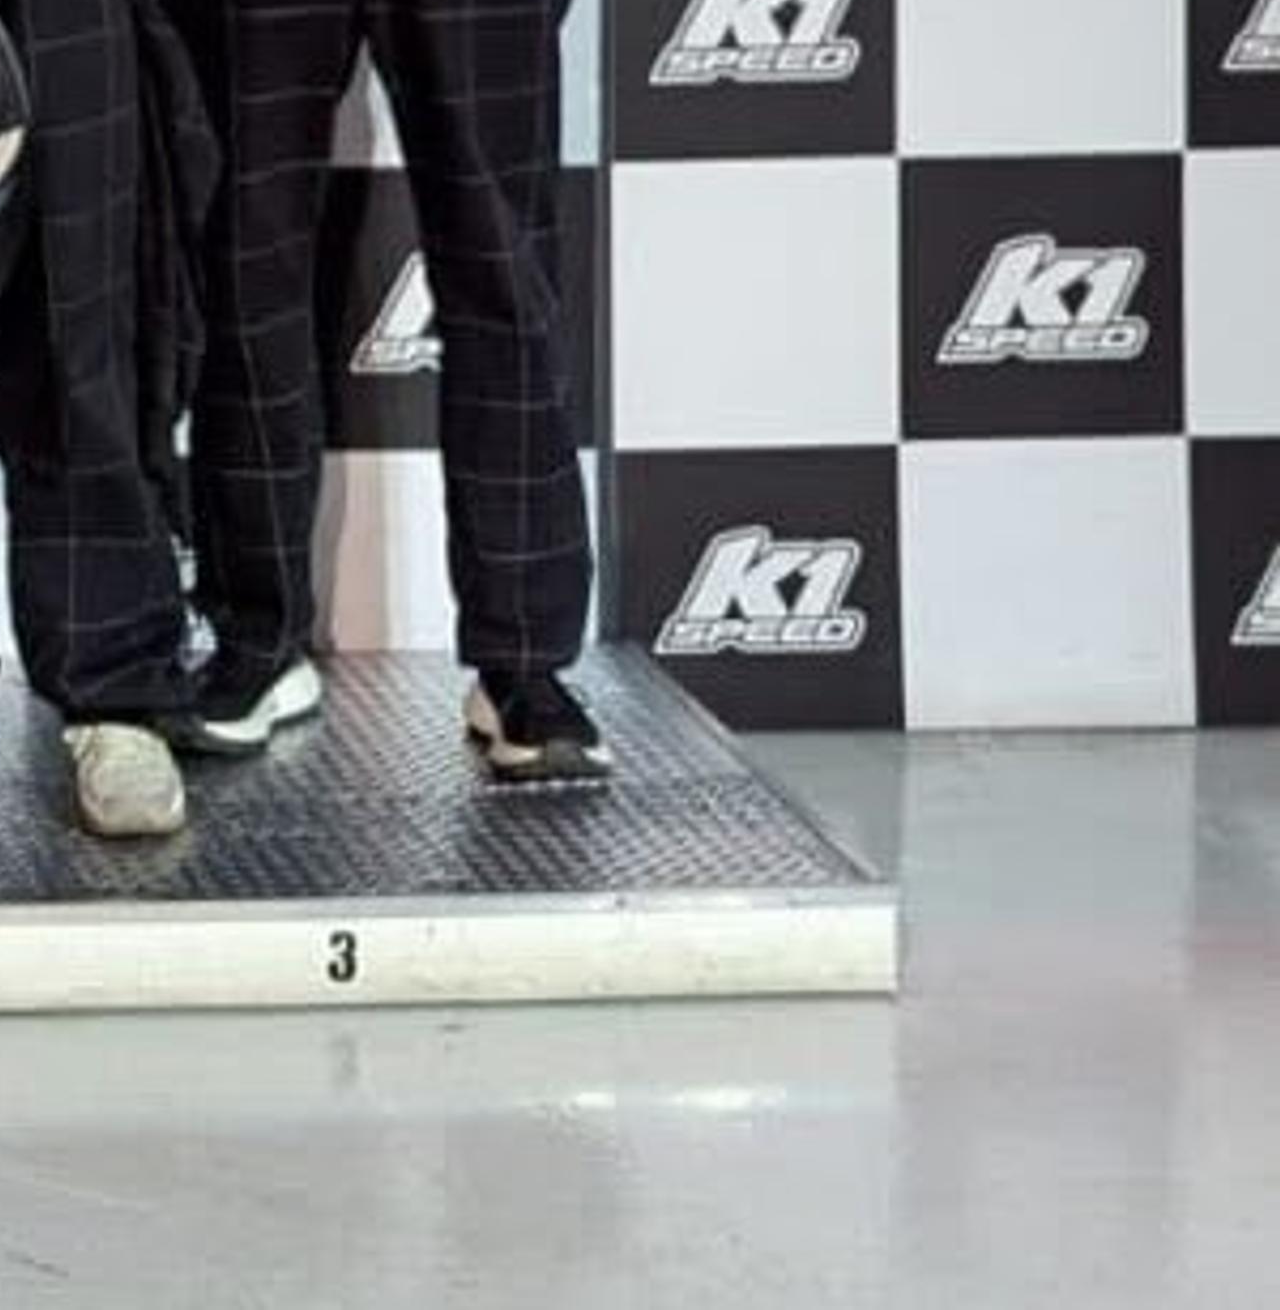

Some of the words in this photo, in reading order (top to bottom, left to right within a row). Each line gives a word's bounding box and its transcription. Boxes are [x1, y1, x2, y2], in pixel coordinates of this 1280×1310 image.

[668, 47, 849, 71] SPEED
[970, 243, 1133, 324] K1
[952, 327, 1136, 349] SPEED
[687, 536, 854, 618] K1
[669, 621, 855, 643] SPEED
[327, 930, 357, 982] 3
